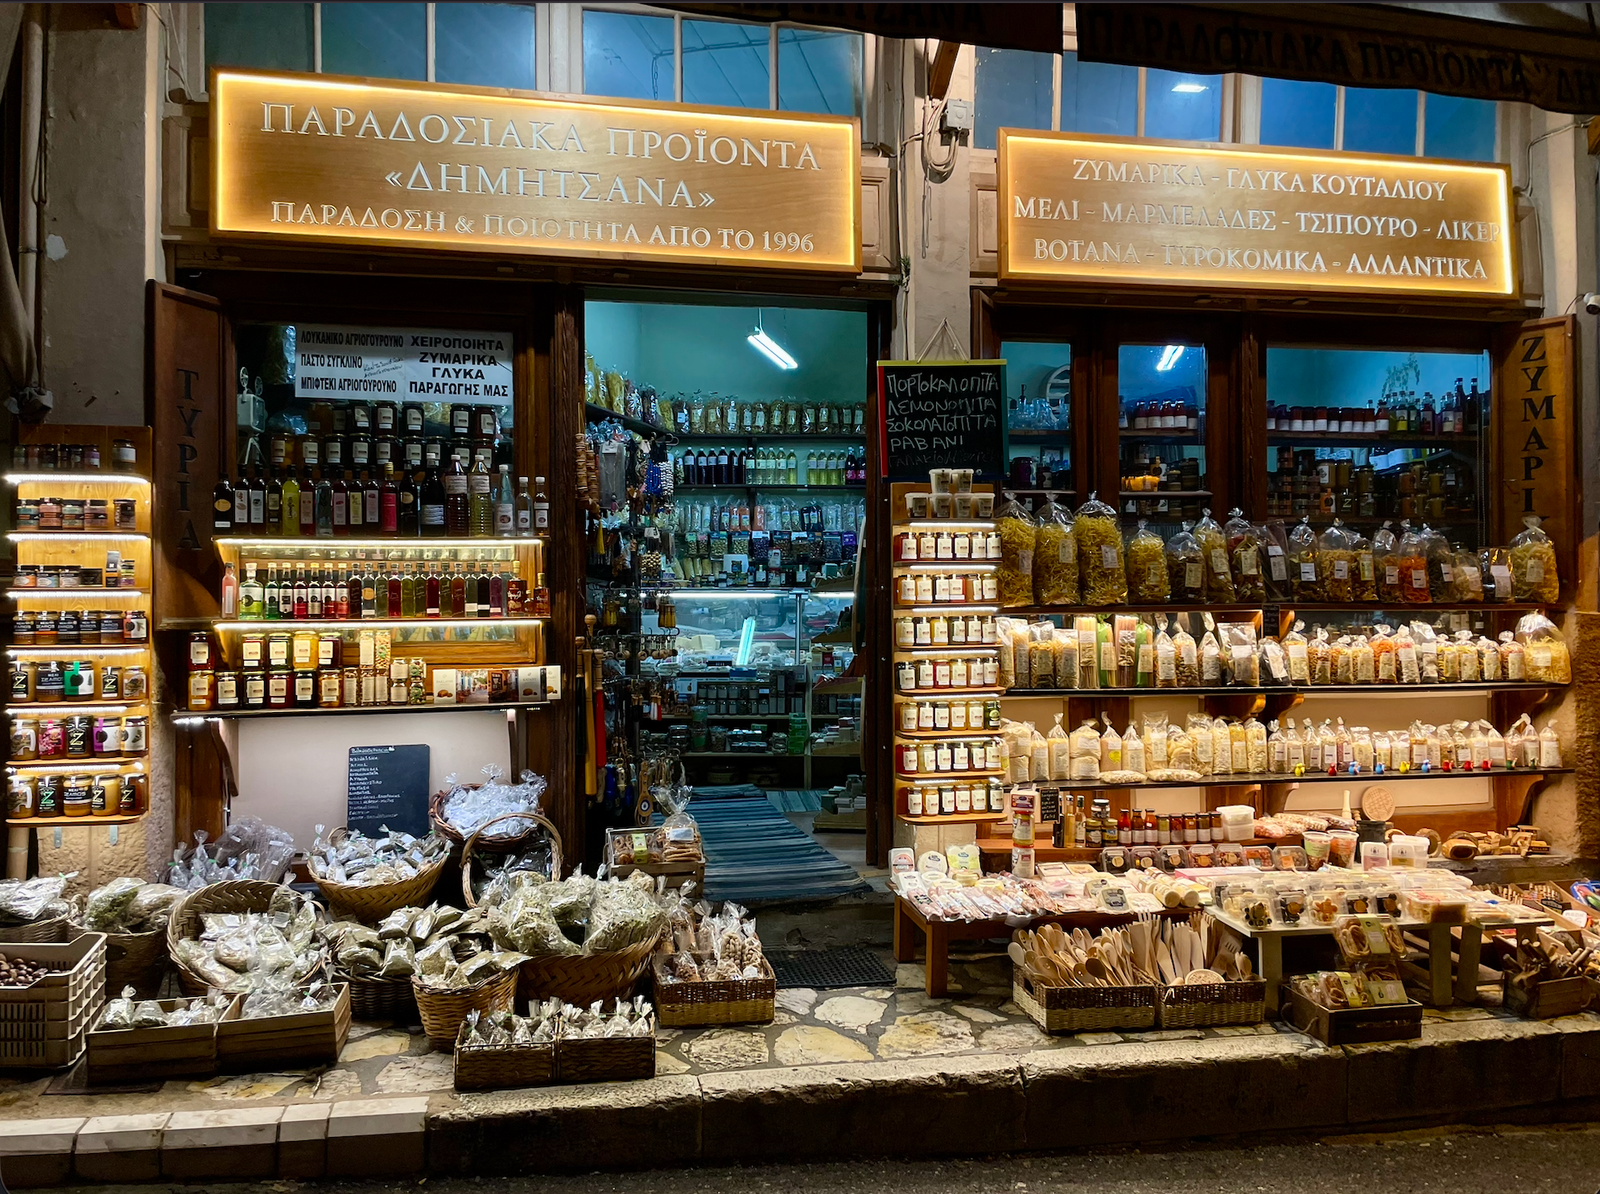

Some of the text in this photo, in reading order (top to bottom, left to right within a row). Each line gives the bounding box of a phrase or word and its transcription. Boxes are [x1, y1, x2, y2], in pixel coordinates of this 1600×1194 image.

[261, 101, 821, 171] ΠΑΡΑΔΟΣΙΑΚΑ ΠΡΟΪΟΝΤΑ
[385, 160, 715, 208] «ΔΗΜΗΤΣΑΝΑ»
[1073, 159, 1206, 187] ΖΥΜΑΡΙΚΑ
[1226, 167, 1306, 192] ΓΛΥΚΑ
[1311, 172, 1448, 201] ΚΟΥΤΑΛΙΟΥ
[271, 201, 814, 253] ΠΑΡΑΔΟΣΗ & ΠΟΙΟΤΗΤΑ ΑΠΟ ΤΟ 1996
[1013, 195, 1080, 221] ΜΕΛΙ
[1101, 202, 1277, 231] ΜΑΡΜΕΛΑΔΕΣ
[1295, 212, 1418, 238] ΤΣΙΠΟΥΡΟ
[1033, 238, 1140, 265] ΒΟΤΑΝΑ
[1160, 244, 1328, 272] ΤΥΡΟΚΟΜΙΚΑ
[1346, 253, 1488, 280] ΑΛΛΑΝΤΙΚΑ
[301, 331, 404, 347] ΛΟΥΚΑΝΙΚΟ ΑΓΡΙΟΓΟΥΡΟΥΝΟ
[411, 335, 504, 351] ΧΕΙΡΟΠΟΙΗΤΑ
[419, 352, 497, 366] ΖΥΜΑΡΙΚΑ
[301, 354, 325, 367] ΠΑΣΤΟ
[327, 355, 363, 368] ΣΥΓΚΛΙΝΟ
[432, 367, 485, 379] ΓΛΥΚΑ
[301, 377, 397, 392] ΜΠΙΦΤΕΚΙ ΑΓΡΙΟΓΟΥΡΟΥΝΟ
[409, 381, 508, 396] ΠΑΡΑΓΩΓΗΣ ΜΑΣ
[1520, 336, 1557, 522] ΖΥΜΑΡΙ
[176, 368, 203, 551] ΤΥΡΙΑ
